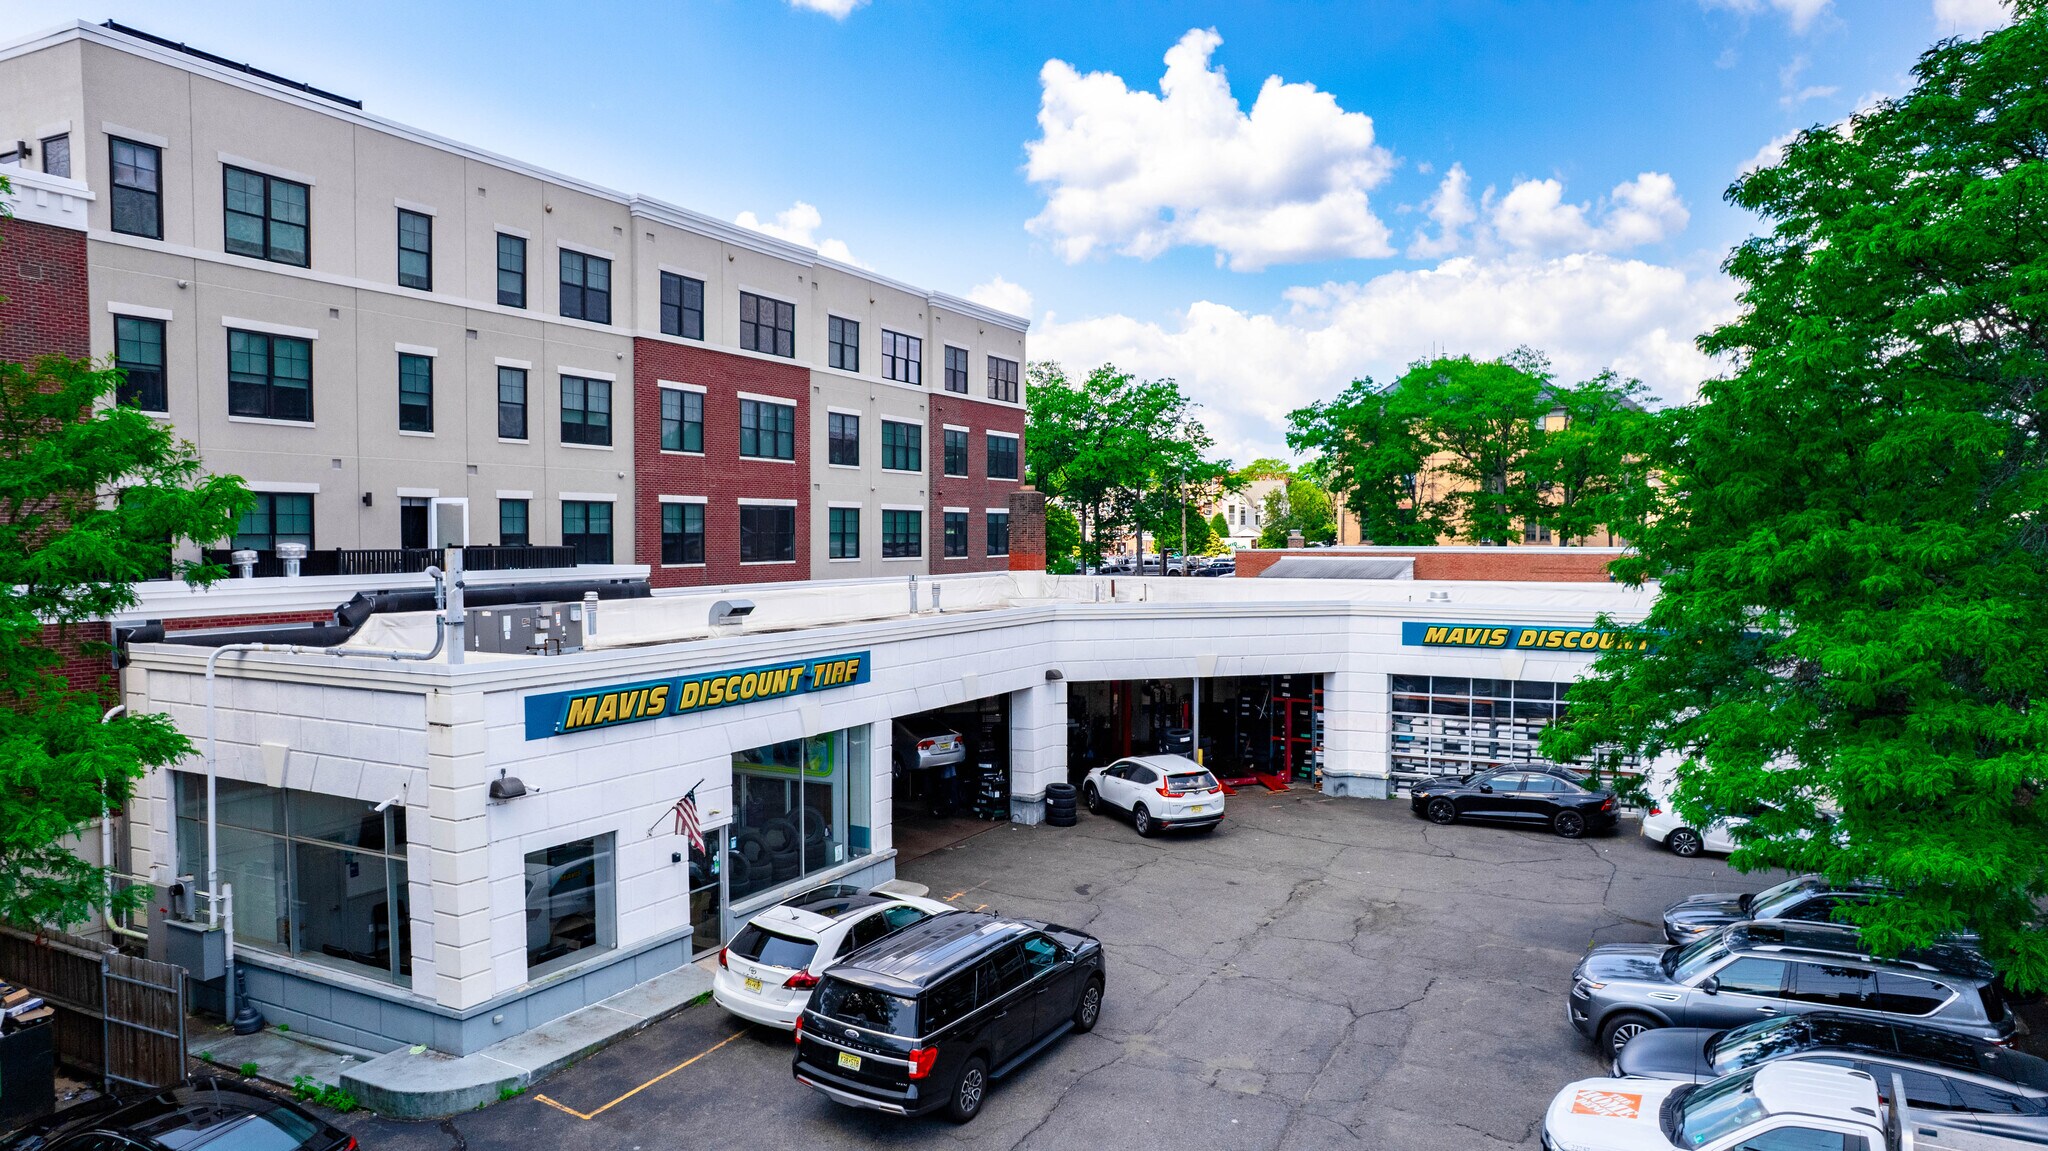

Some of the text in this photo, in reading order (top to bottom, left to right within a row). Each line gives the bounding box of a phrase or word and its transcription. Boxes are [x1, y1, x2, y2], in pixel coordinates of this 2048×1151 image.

[1424, 627, 1508, 646] MAVIS
[566, 686, 669, 728] MAVIS
[680, 667, 804, 709] DISCOUNT
[1577, 1090, 1638, 1118] HOME
